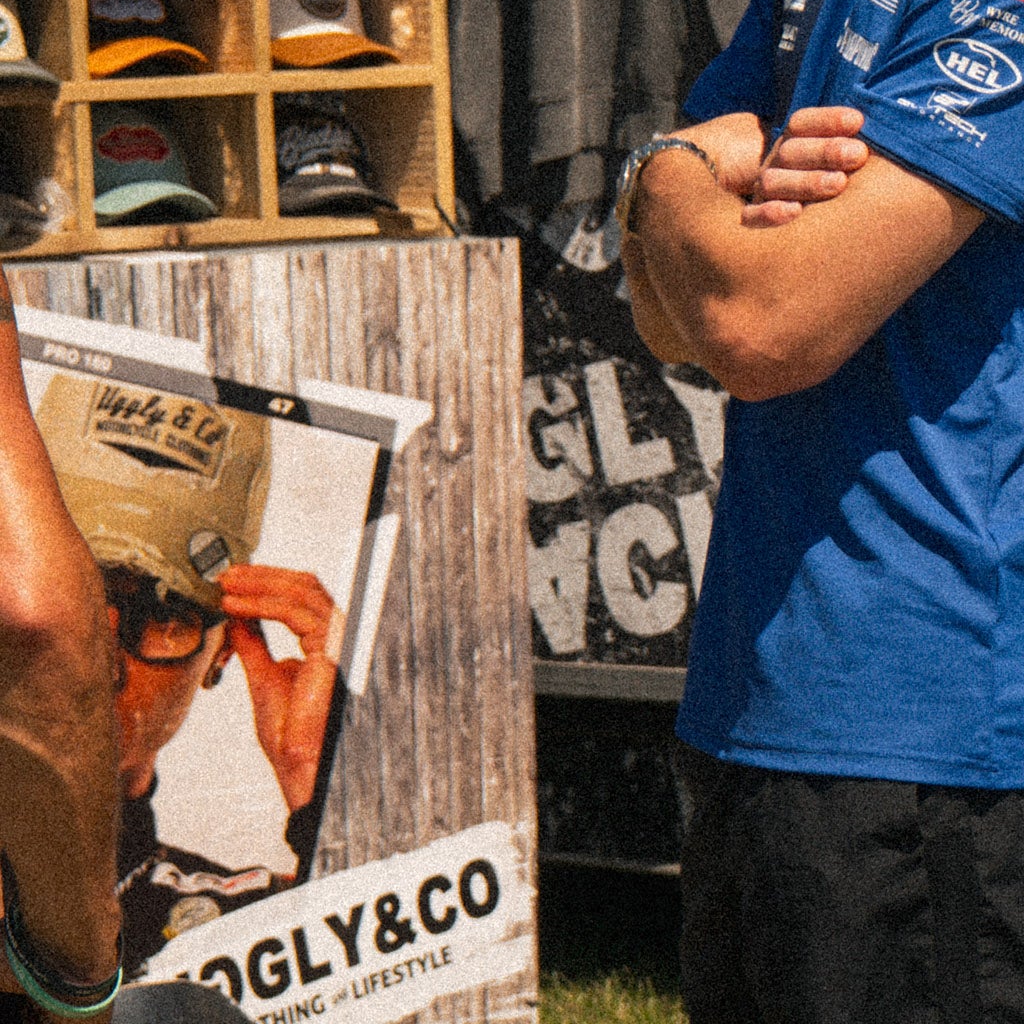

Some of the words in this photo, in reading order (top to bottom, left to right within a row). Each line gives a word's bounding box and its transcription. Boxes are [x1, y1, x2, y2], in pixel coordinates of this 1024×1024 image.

[946, 51, 1003, 90] HEL
[96, 383, 166, 428] Uggly
[172, 404, 197, 430] &
[351, 945, 454, 999] LIFESTYLE
